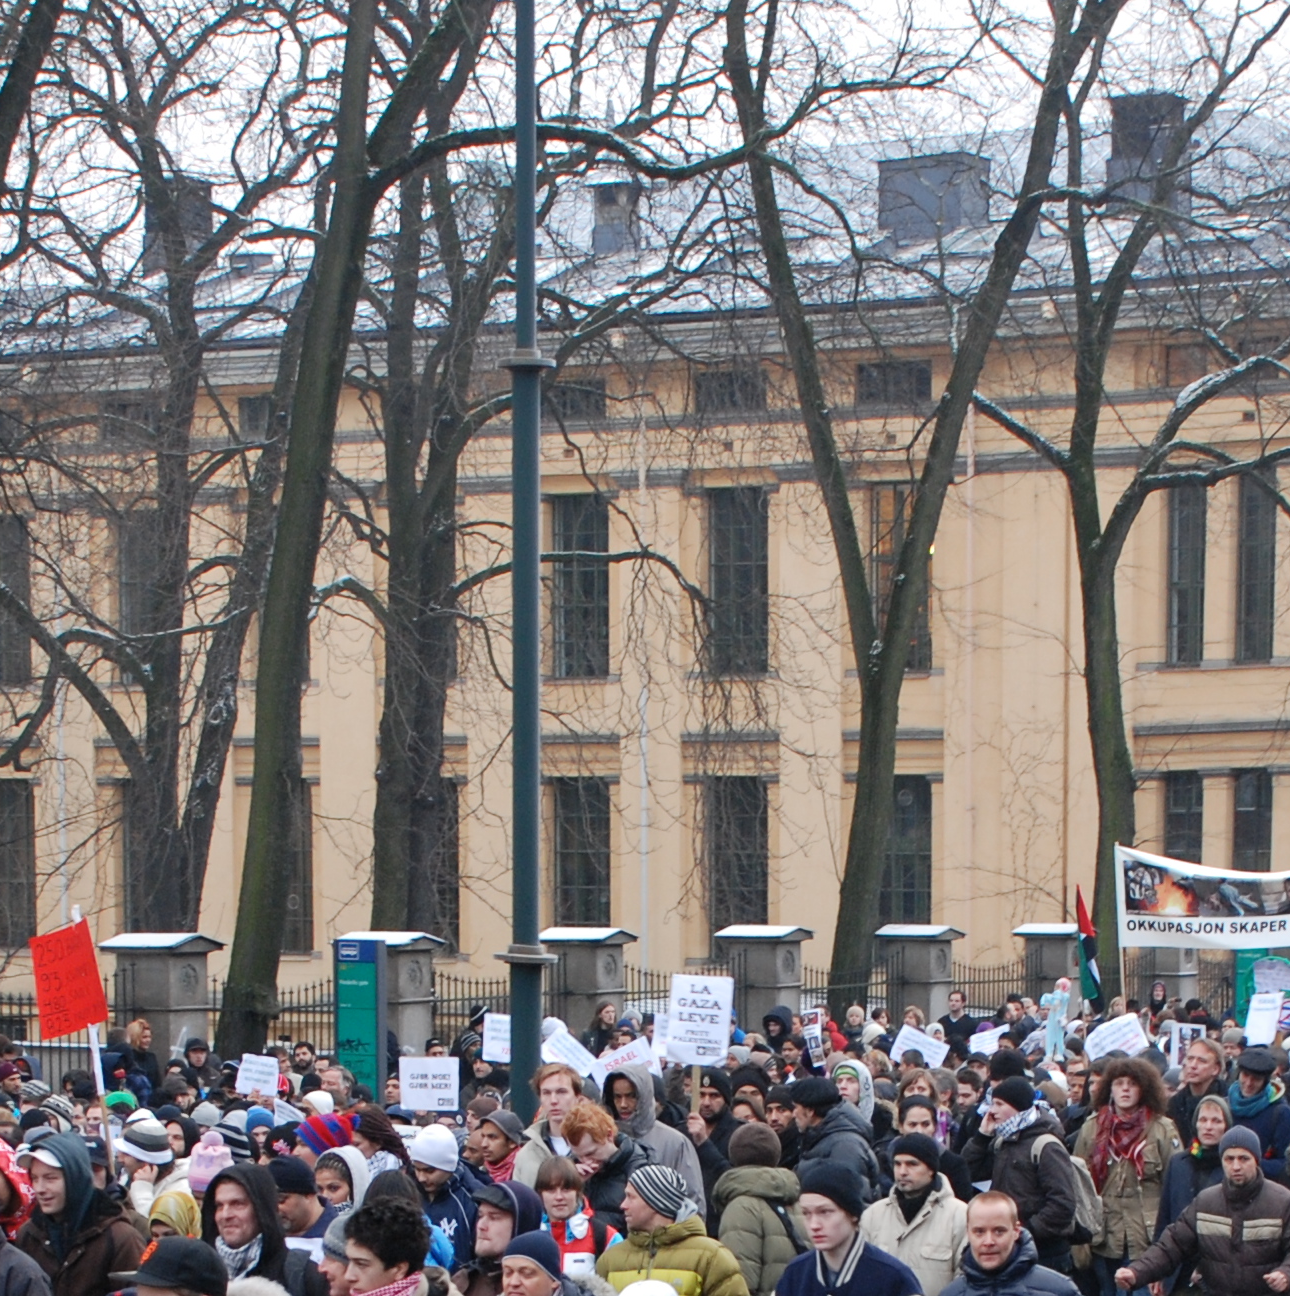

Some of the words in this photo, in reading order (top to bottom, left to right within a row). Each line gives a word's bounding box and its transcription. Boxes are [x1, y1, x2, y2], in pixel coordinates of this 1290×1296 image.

[1126, 918, 1224, 935] OKKUPASJON
[1229, 920, 1287, 934] SKAPER
[690, 983, 712, 995] LA
[677, 998, 722, 1010] GAZA
[679, 1012, 720, 1024] LEVE
[604, 1051, 639, 1072] ISRAEL
